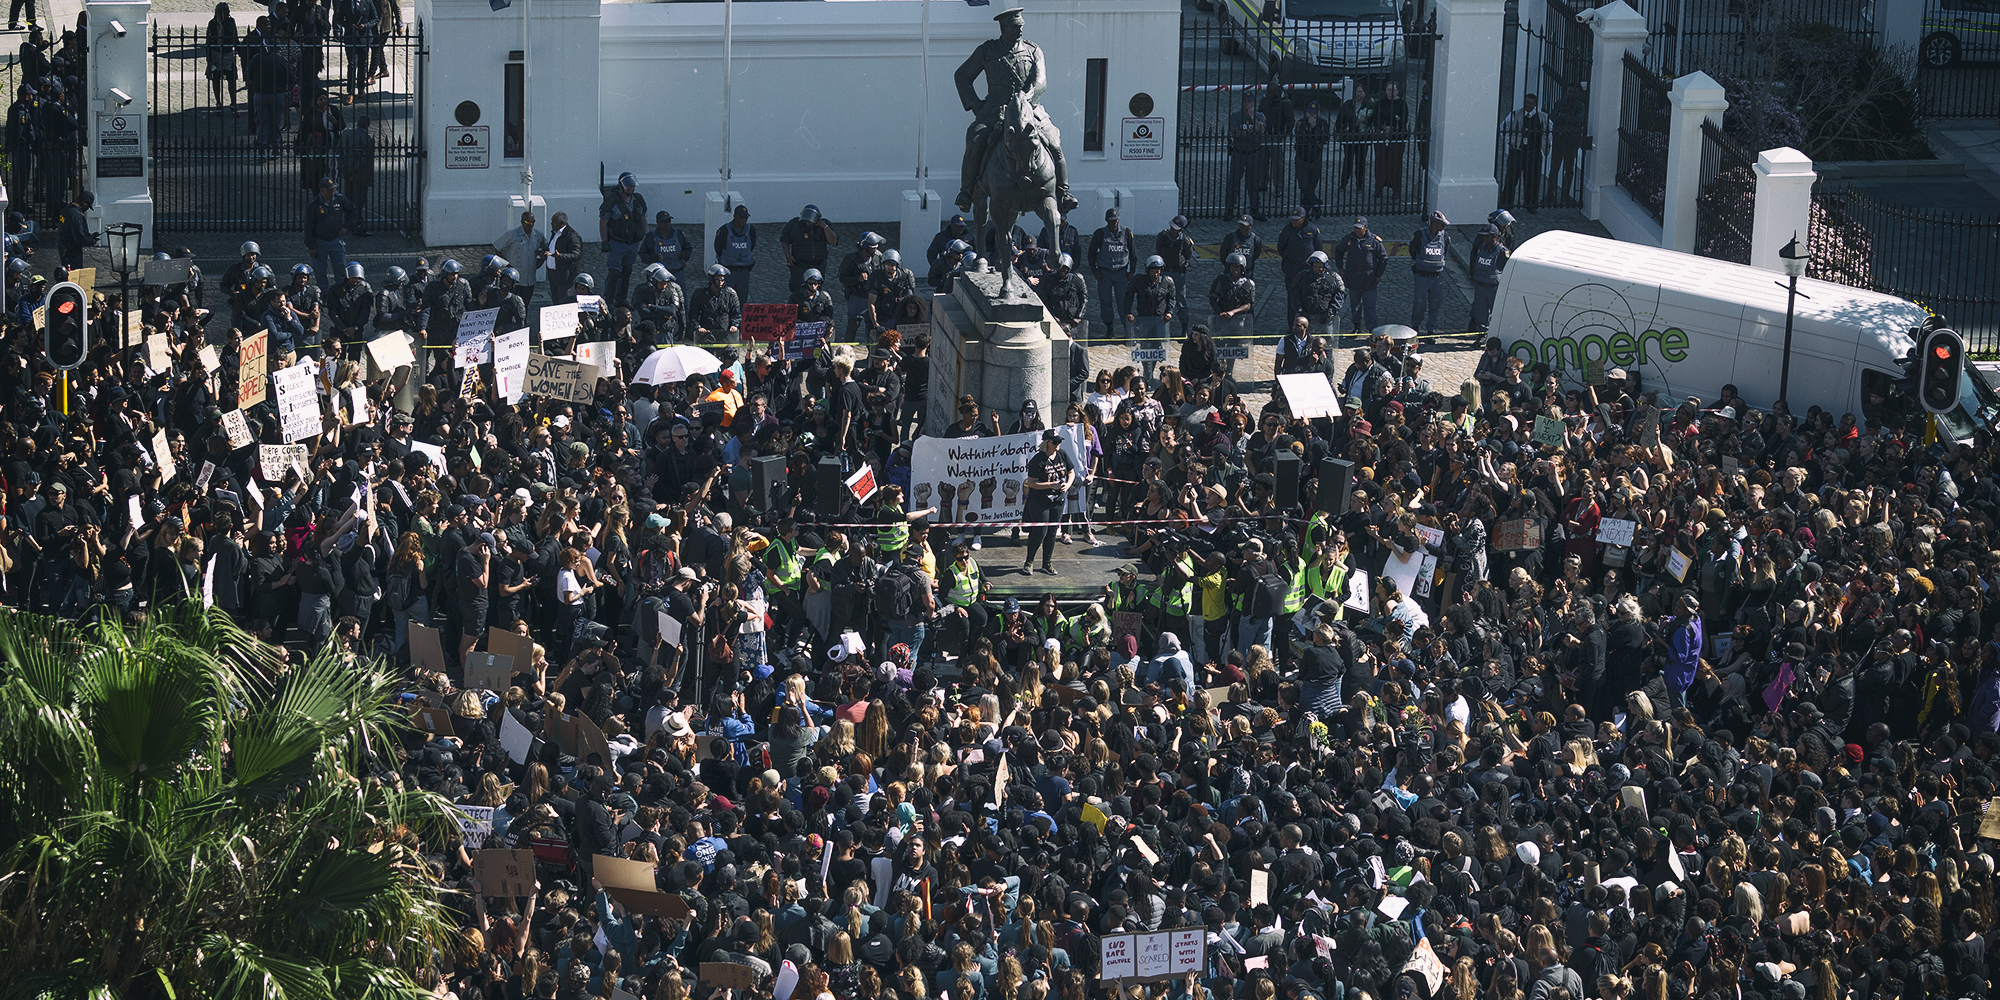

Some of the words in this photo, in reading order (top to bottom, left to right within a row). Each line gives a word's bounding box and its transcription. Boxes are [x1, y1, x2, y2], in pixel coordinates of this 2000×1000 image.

[1478, 257, 1492, 265] POLICE
[545, 310, 572, 321] ENOUGH
[1134, 351, 1164, 360] POLICE
[1217, 349, 1246, 358] POLICE
[501, 363, 521, 372] CHOICE
[528, 359, 564, 378] SAVE
[566, 370, 582, 380] THE
[531, 380, 572, 400] WOMEN
[1542, 418, 1555, 428] AM
[993, 511, 1013, 519] Justice
[1600, 528, 1633, 541] NEXT?
[696, 845, 715, 858] ONE
[1108, 941, 1125, 949] END
[1106, 949, 1125, 958] RAPE
[1139, 953, 1169, 964] SCARED
